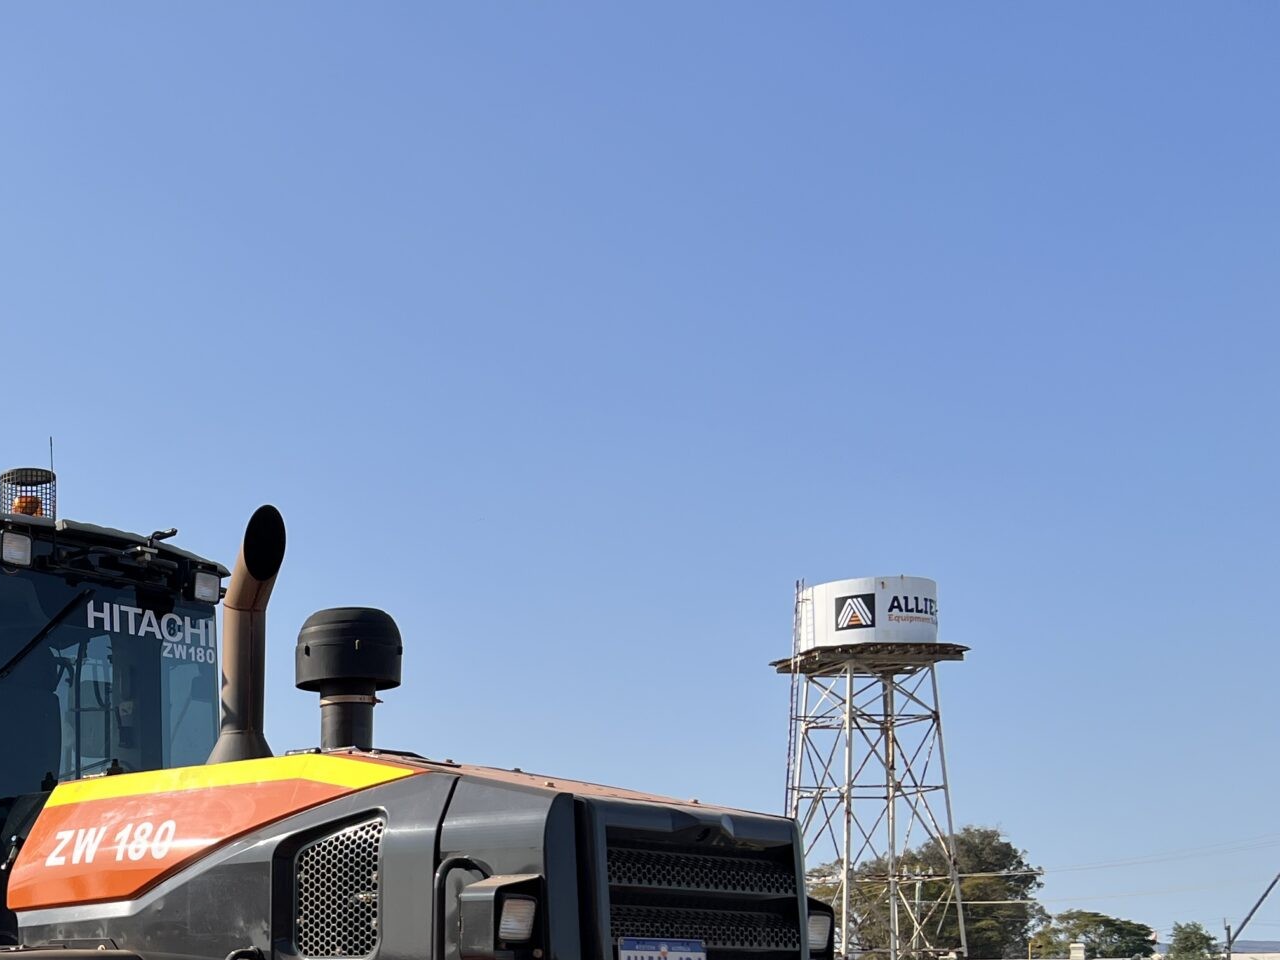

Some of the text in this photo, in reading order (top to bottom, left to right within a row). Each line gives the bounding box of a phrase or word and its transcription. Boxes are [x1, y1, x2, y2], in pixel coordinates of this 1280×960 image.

[888, 596, 937, 615] ALLIE
[87, 600, 215, 647] HITACHI
[162, 642, 215, 663] ZW180
